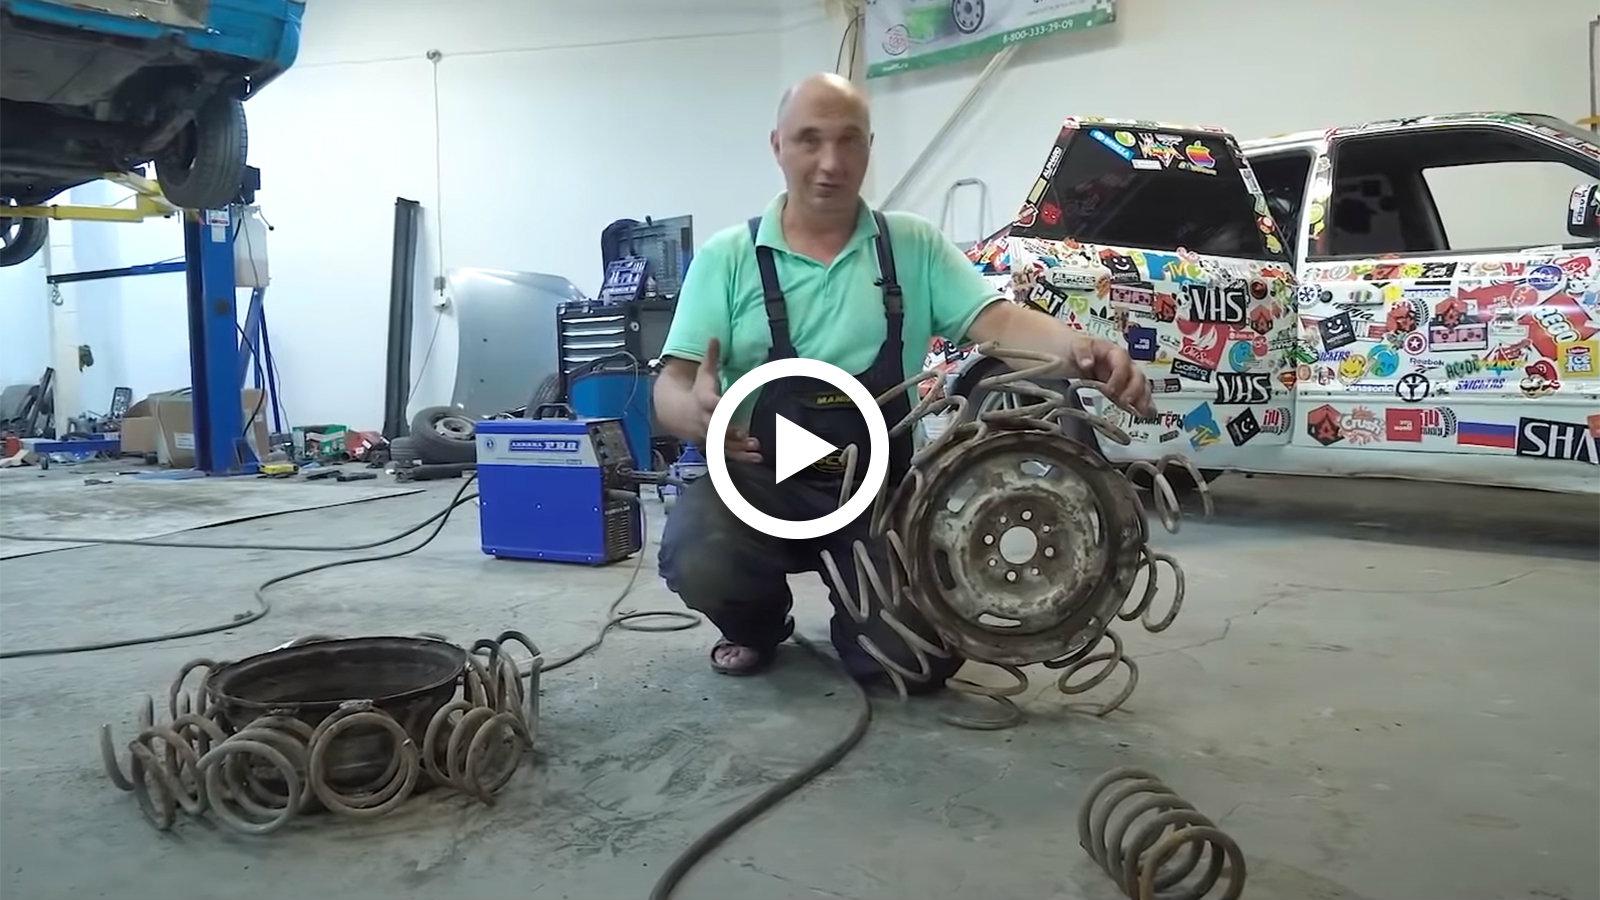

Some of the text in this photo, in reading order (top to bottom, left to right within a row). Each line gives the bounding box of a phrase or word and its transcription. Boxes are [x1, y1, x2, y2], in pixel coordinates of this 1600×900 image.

[1029, 283, 1063, 313] CAT
[1189, 287, 1243, 323] VHS
[1535, 308, 1579, 345] LEGO
[1174, 362, 1209, 378] GoPro
[1219, 374, 1270, 403] VHS
[1345, 383, 1394, 393] Panasonic
[1340, 414, 1381, 435] Crush
